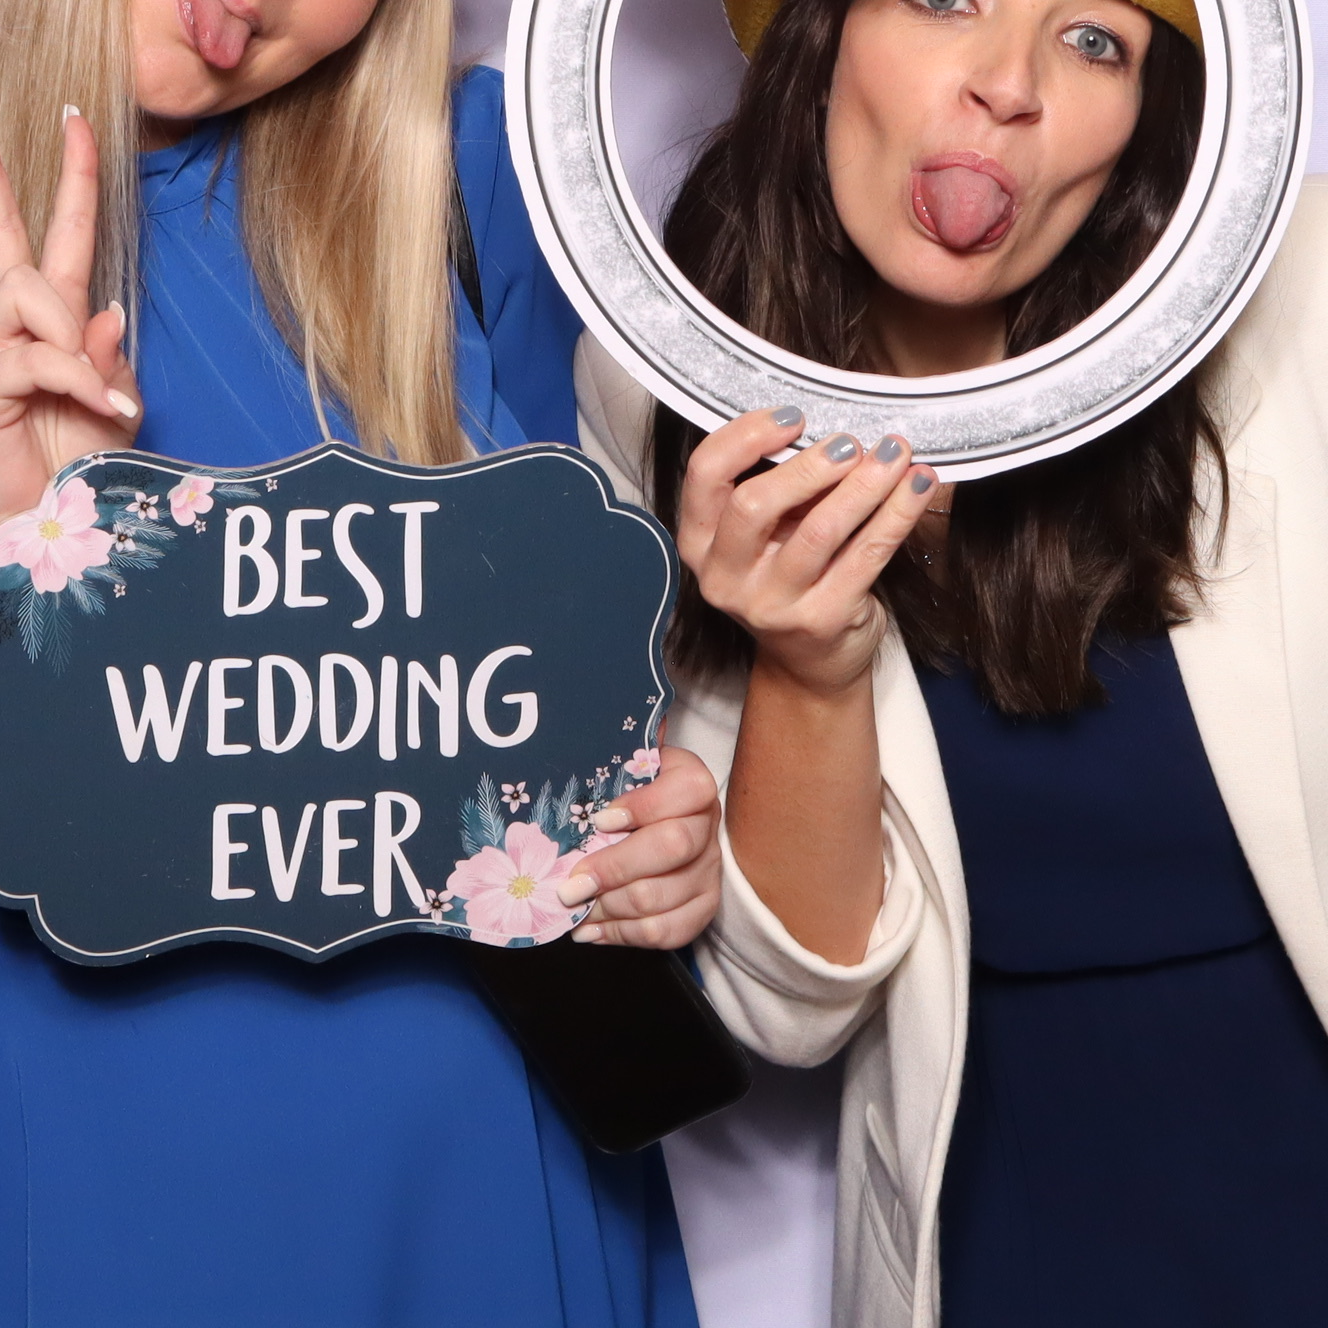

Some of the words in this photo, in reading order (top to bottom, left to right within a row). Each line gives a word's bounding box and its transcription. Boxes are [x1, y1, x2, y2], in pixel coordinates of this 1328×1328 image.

[222, 500, 441, 630] BEST
[104, 644, 540, 764] WEDDING
[209, 790, 428, 918] EVER
